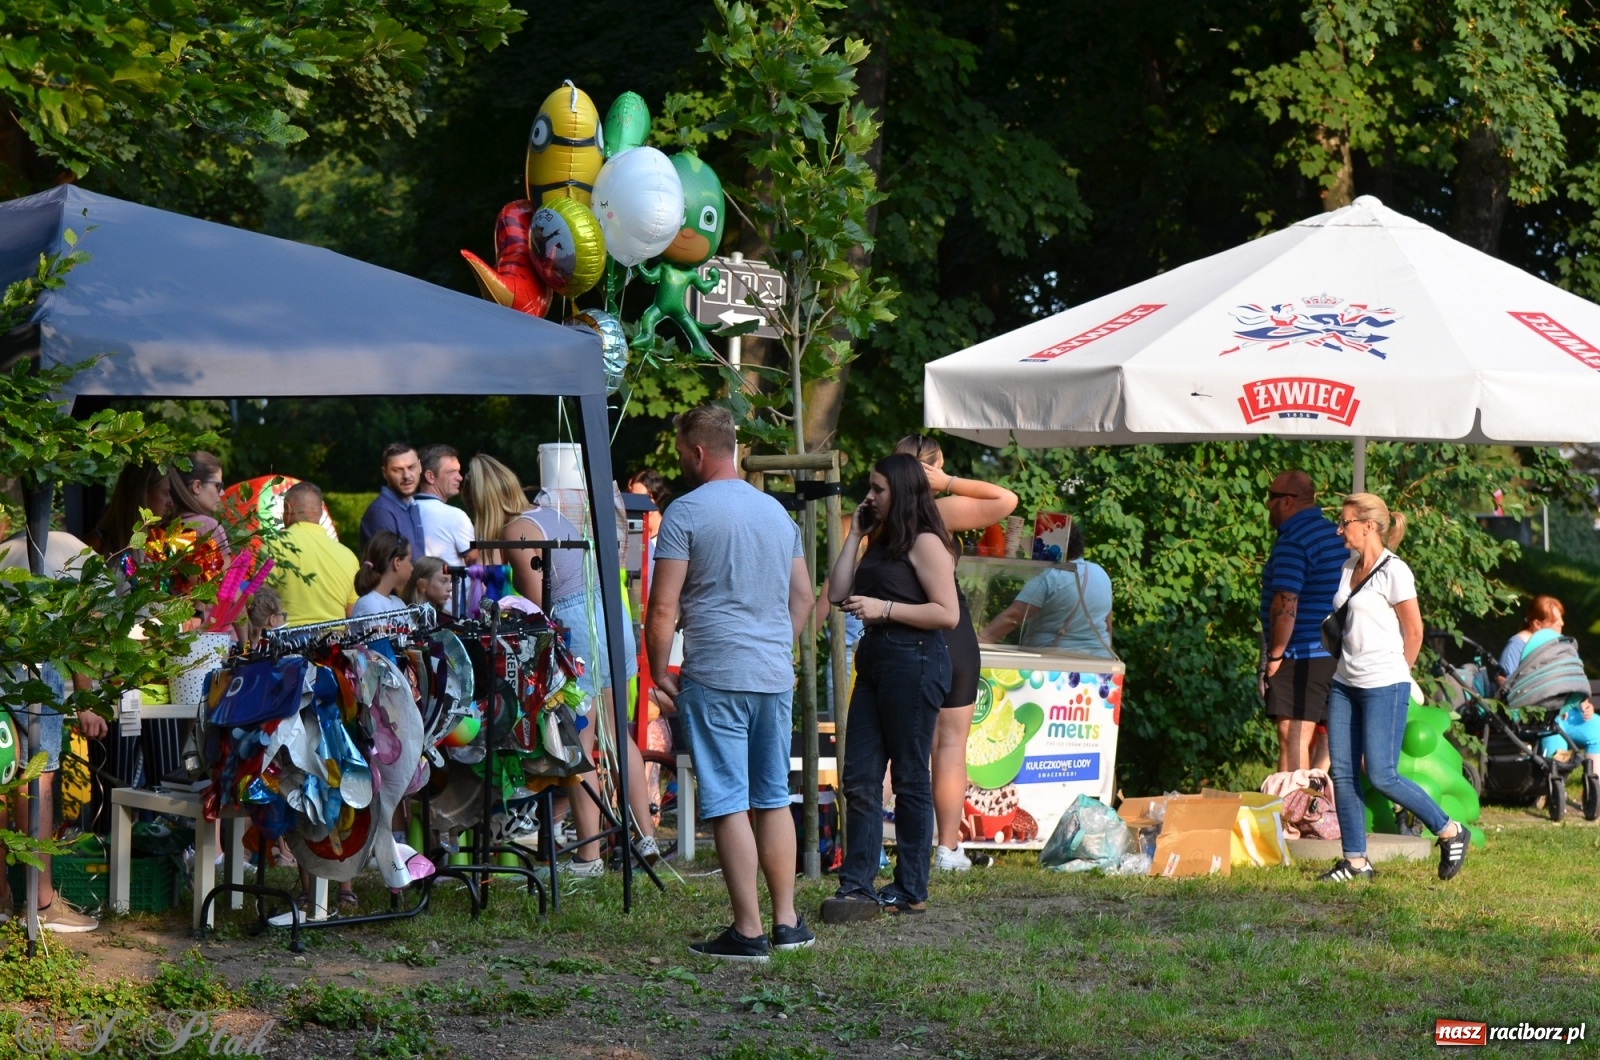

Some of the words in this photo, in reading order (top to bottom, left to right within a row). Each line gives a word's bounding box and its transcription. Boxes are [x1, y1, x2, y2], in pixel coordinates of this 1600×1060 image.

[1253, 382, 1346, 411] ŻYWIEC
[1049, 693, 1092, 722] mini
[1025, 760, 1073, 771] KULECZKOWE
[1073, 759, 1091, 769] LODY
